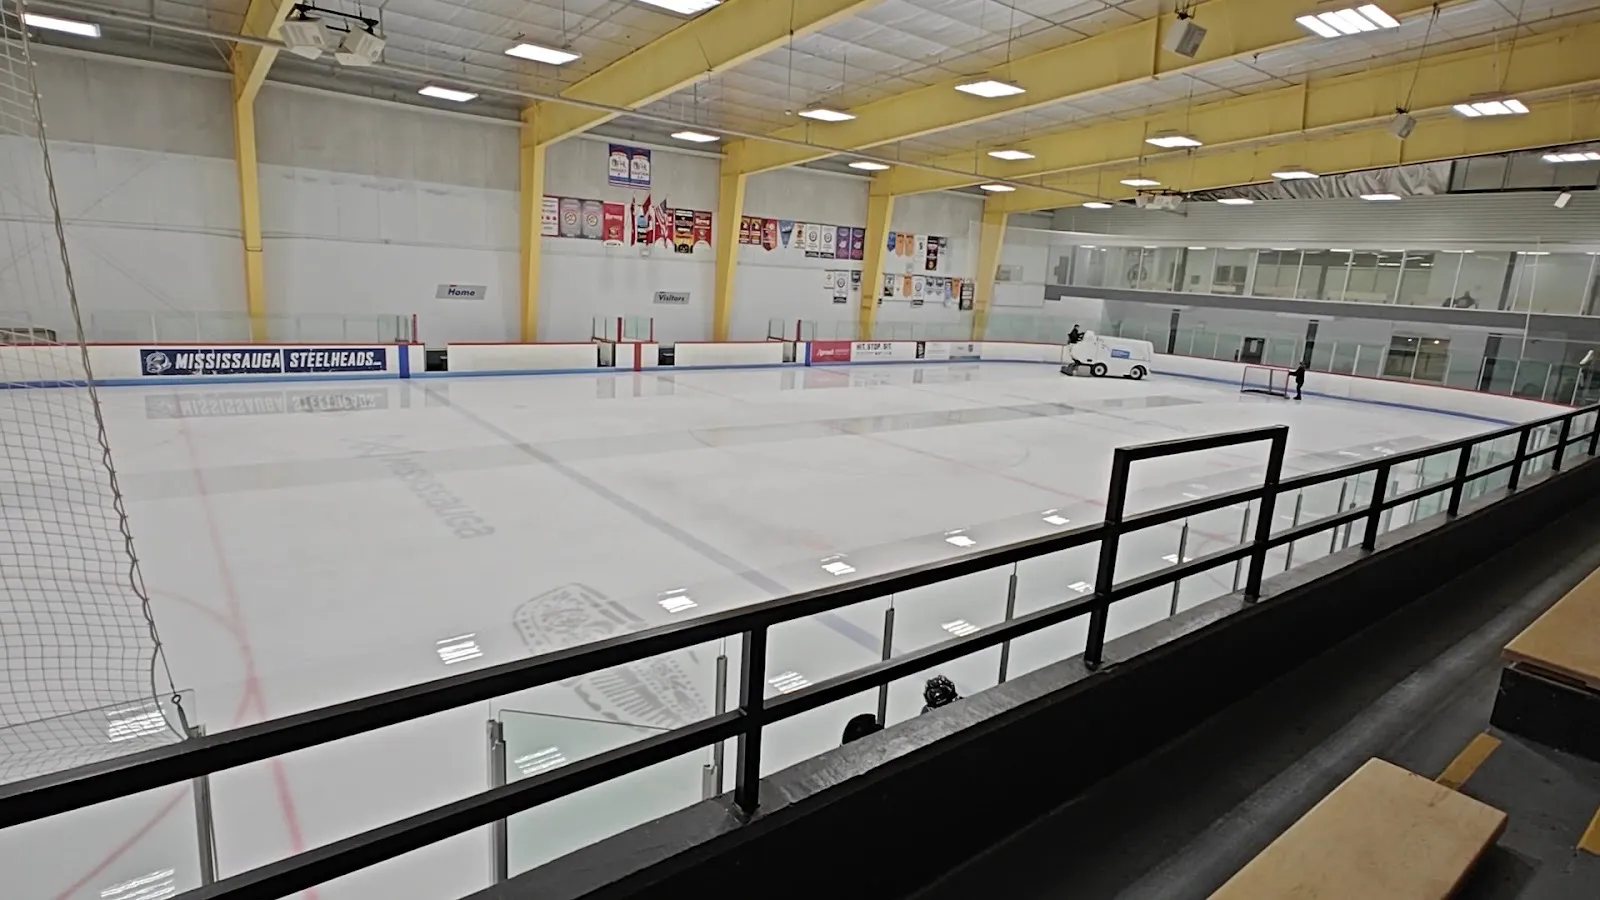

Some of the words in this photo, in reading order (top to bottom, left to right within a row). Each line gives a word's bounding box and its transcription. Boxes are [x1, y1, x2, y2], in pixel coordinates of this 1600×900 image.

[448, 287, 476, 297] Home
[658, 294, 685, 302] Visitors
[175, 352, 280, 370] MISSISSAUGA
